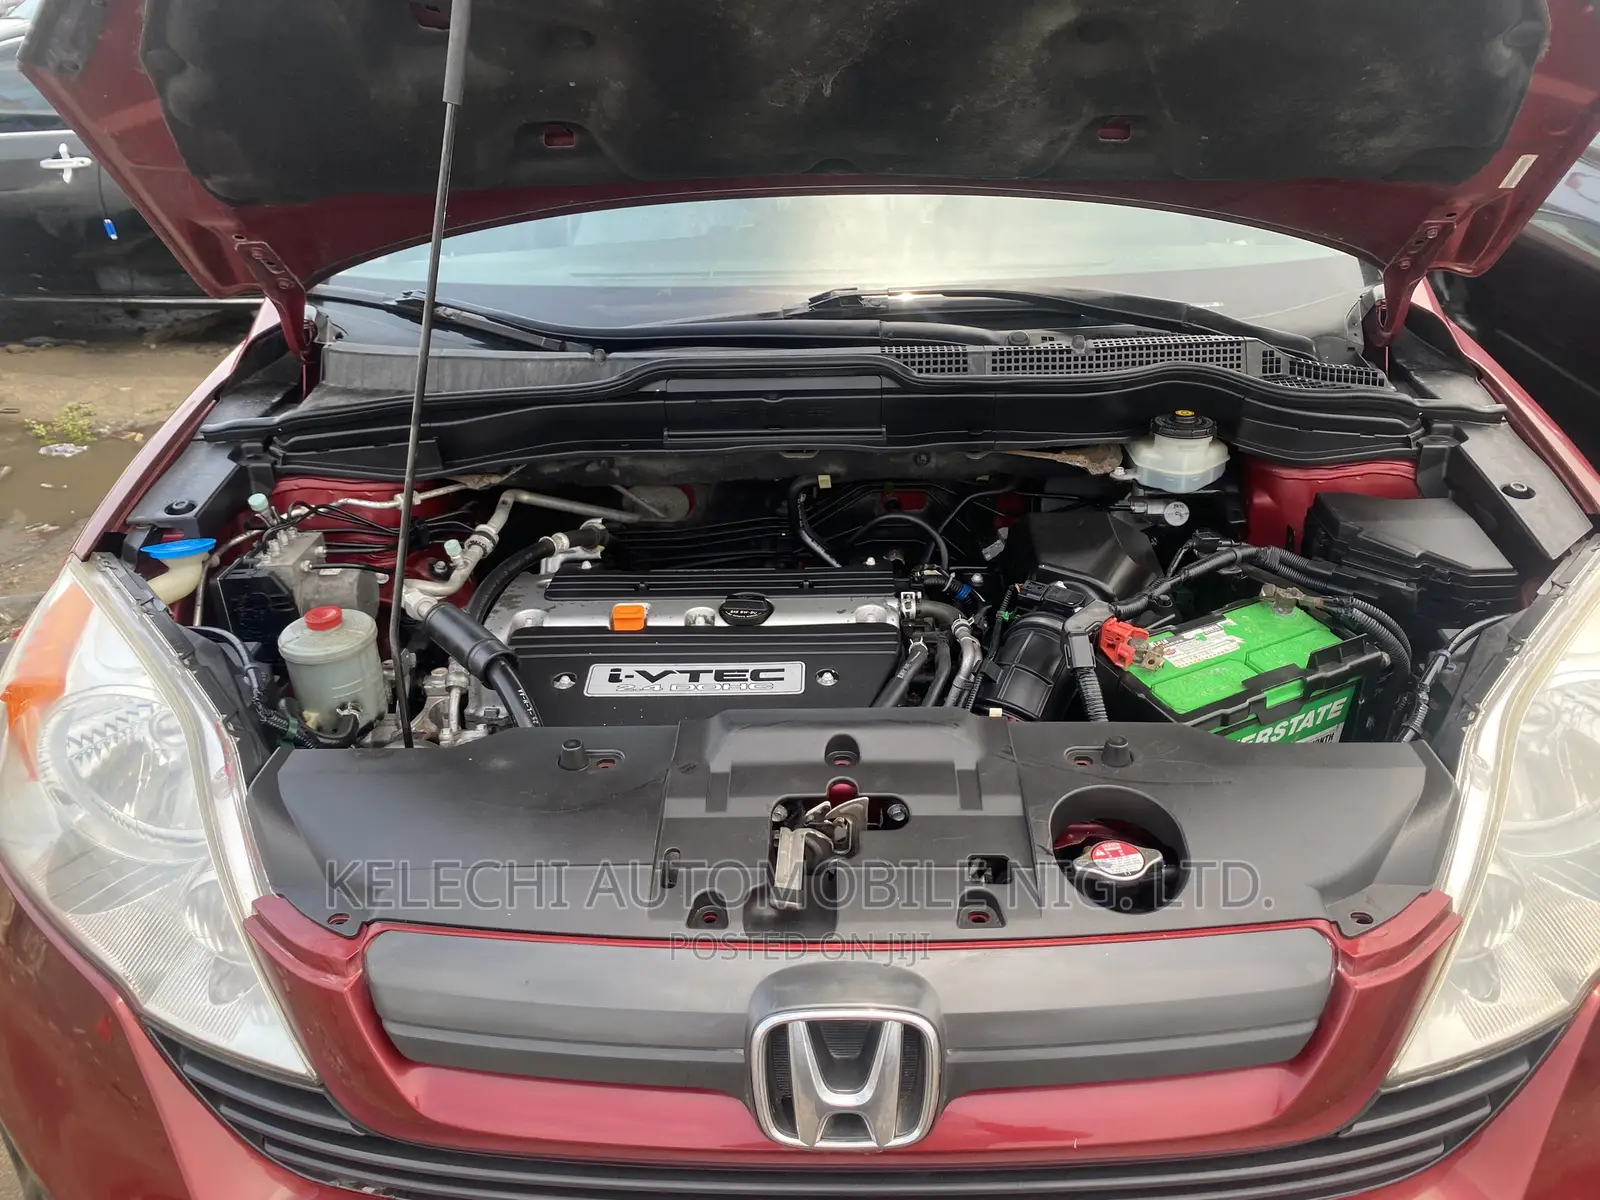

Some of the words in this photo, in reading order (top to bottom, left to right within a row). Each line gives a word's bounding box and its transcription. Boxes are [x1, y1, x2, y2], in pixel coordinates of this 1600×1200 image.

[607, 668, 785, 684] i-VTEC
[615, 683, 663, 692] 2.4
[669, 682, 774, 692] DOHC
